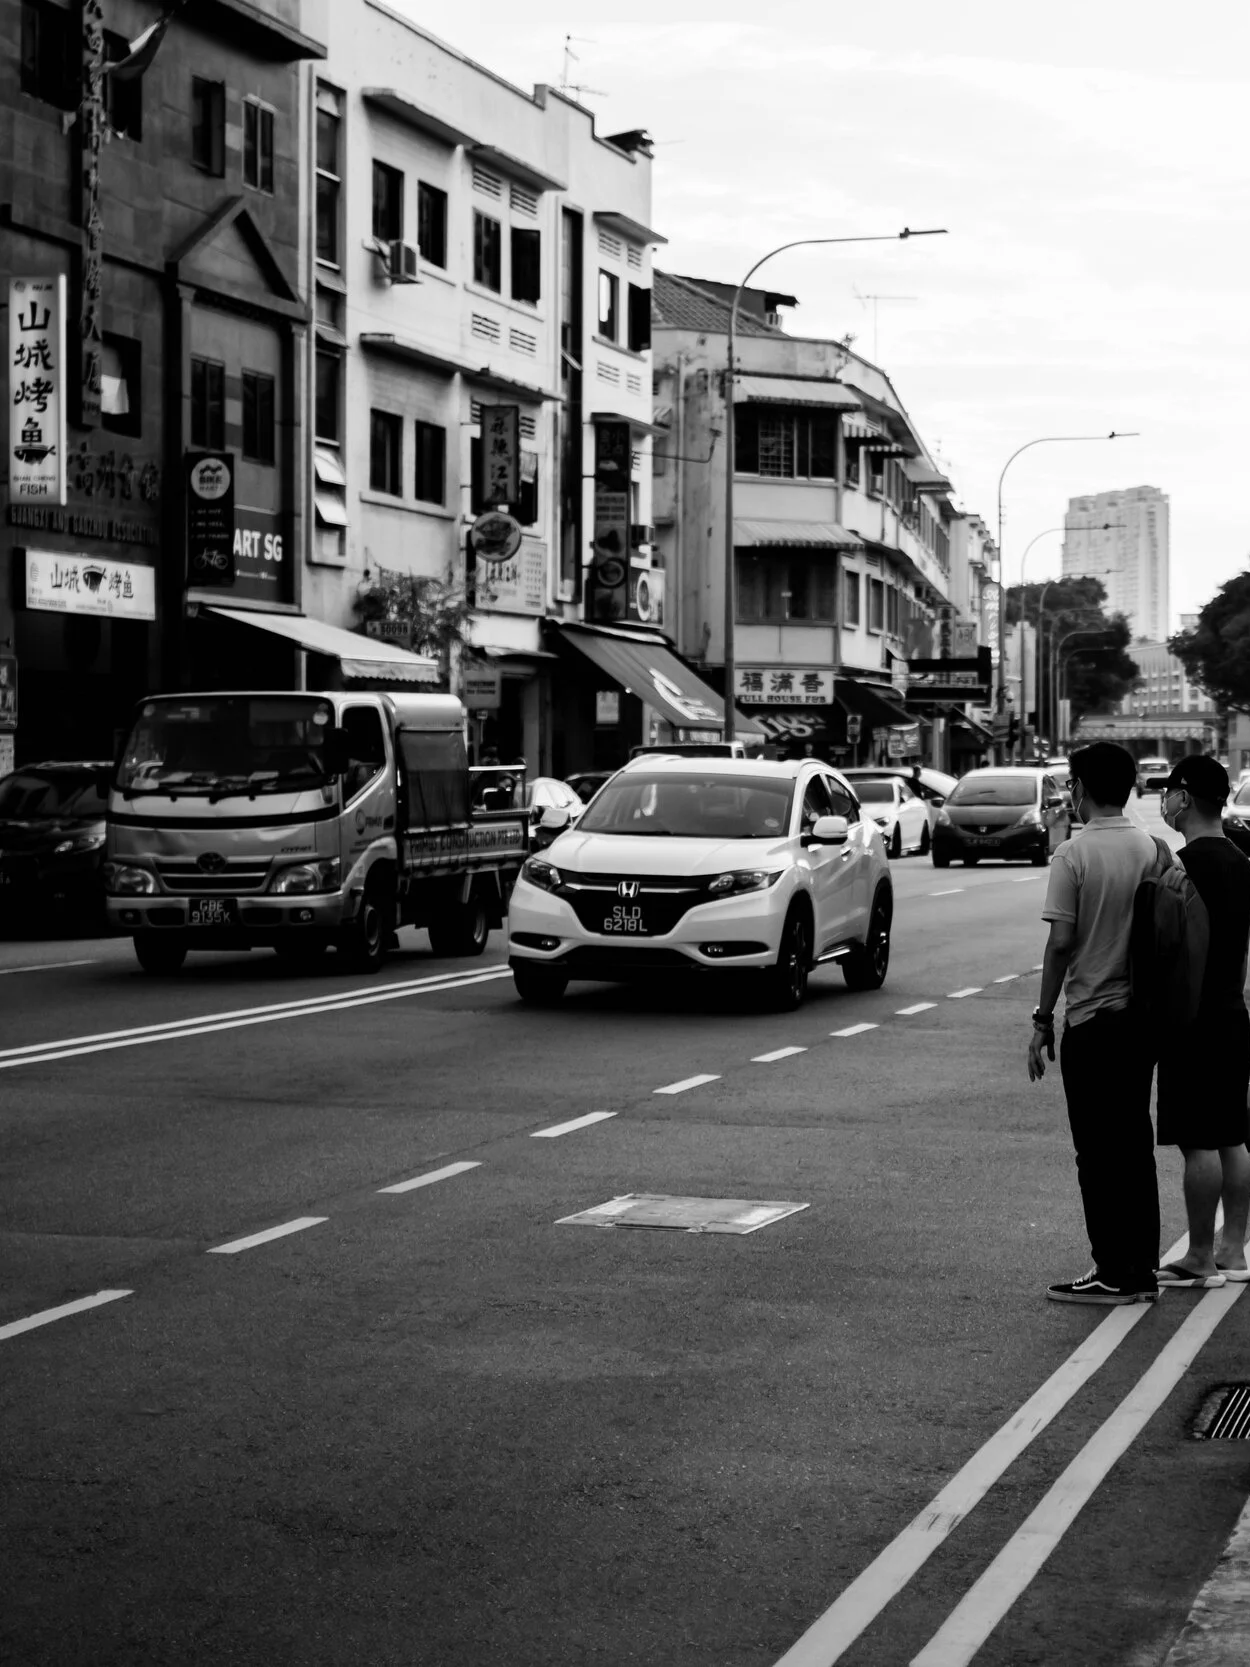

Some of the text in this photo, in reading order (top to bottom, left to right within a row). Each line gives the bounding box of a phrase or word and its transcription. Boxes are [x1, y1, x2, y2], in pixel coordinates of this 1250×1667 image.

[20, 484, 47, 496] FISH
[233, 527, 283, 562] ART SG
[738, 694, 763, 703] FULL
[766, 695, 801, 703] HOUSE
[612, 905, 641, 919] SLD
[603, 917, 648, 932] 6218L
